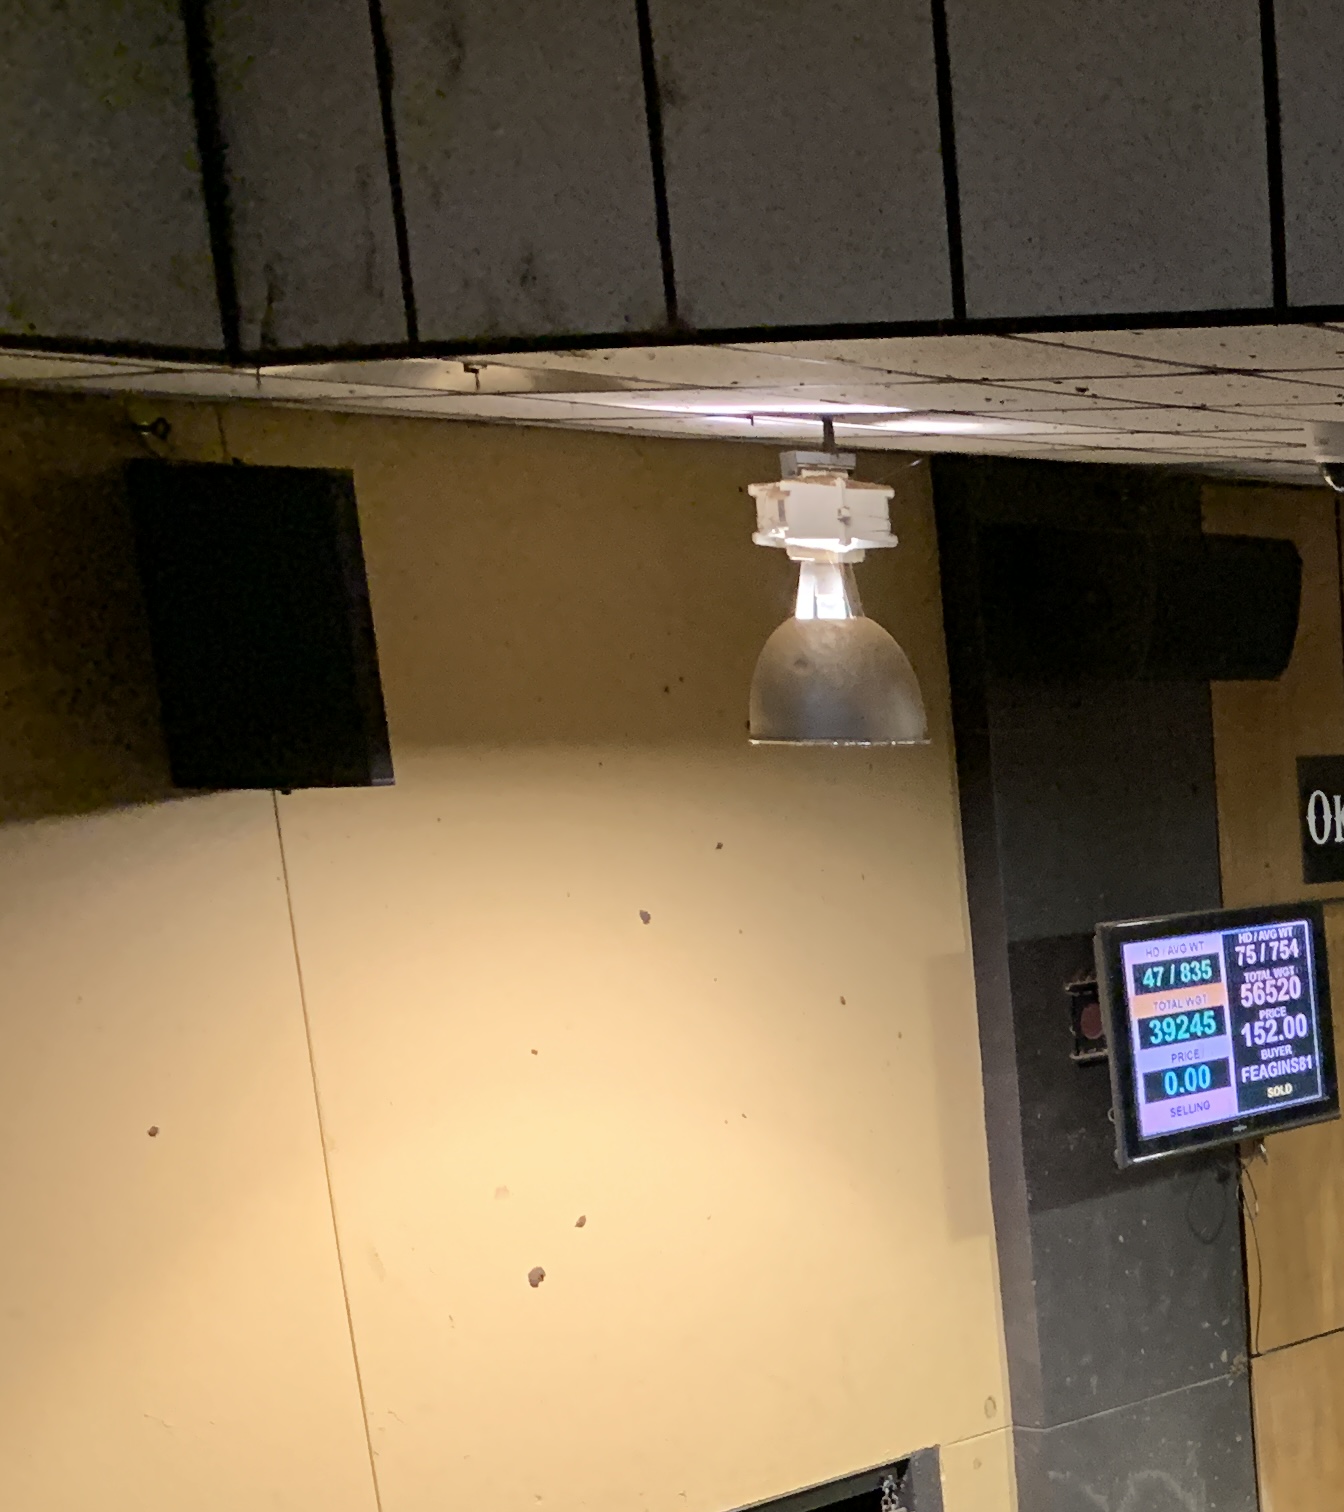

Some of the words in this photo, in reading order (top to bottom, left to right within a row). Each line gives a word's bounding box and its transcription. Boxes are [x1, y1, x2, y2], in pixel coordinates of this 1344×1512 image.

[1237, 932, 1253, 944] HD
[1258, 928, 1278, 942] AVG
[1278, 926, 1294, 939] WT
[1235, 943, 1257, 967] 75
[1269, 937, 1299, 961] 754
[1142, 965, 1165, 988] 47
[1180, 958, 1213, 983] 835
[1243, 968, 1273, 983] TOTAL
[1240, 974, 1301, 1008] 56520
[1153, 999, 1183, 1012] TOTAL
[1258, 1005, 1287, 1020] PRICE
[1148, 1009, 1217, 1045] 39245
[1240, 1012, 1308, 1047] 152.00
[1171, 1048, 1200, 1063] PRICE
[1260, 1044, 1293, 1060] BUYER
[1164, 1064, 1211, 1096] 0.00
[1266, 1081, 1293, 1099] SOLD
[1170, 1099, 1211, 1118] SELLING
